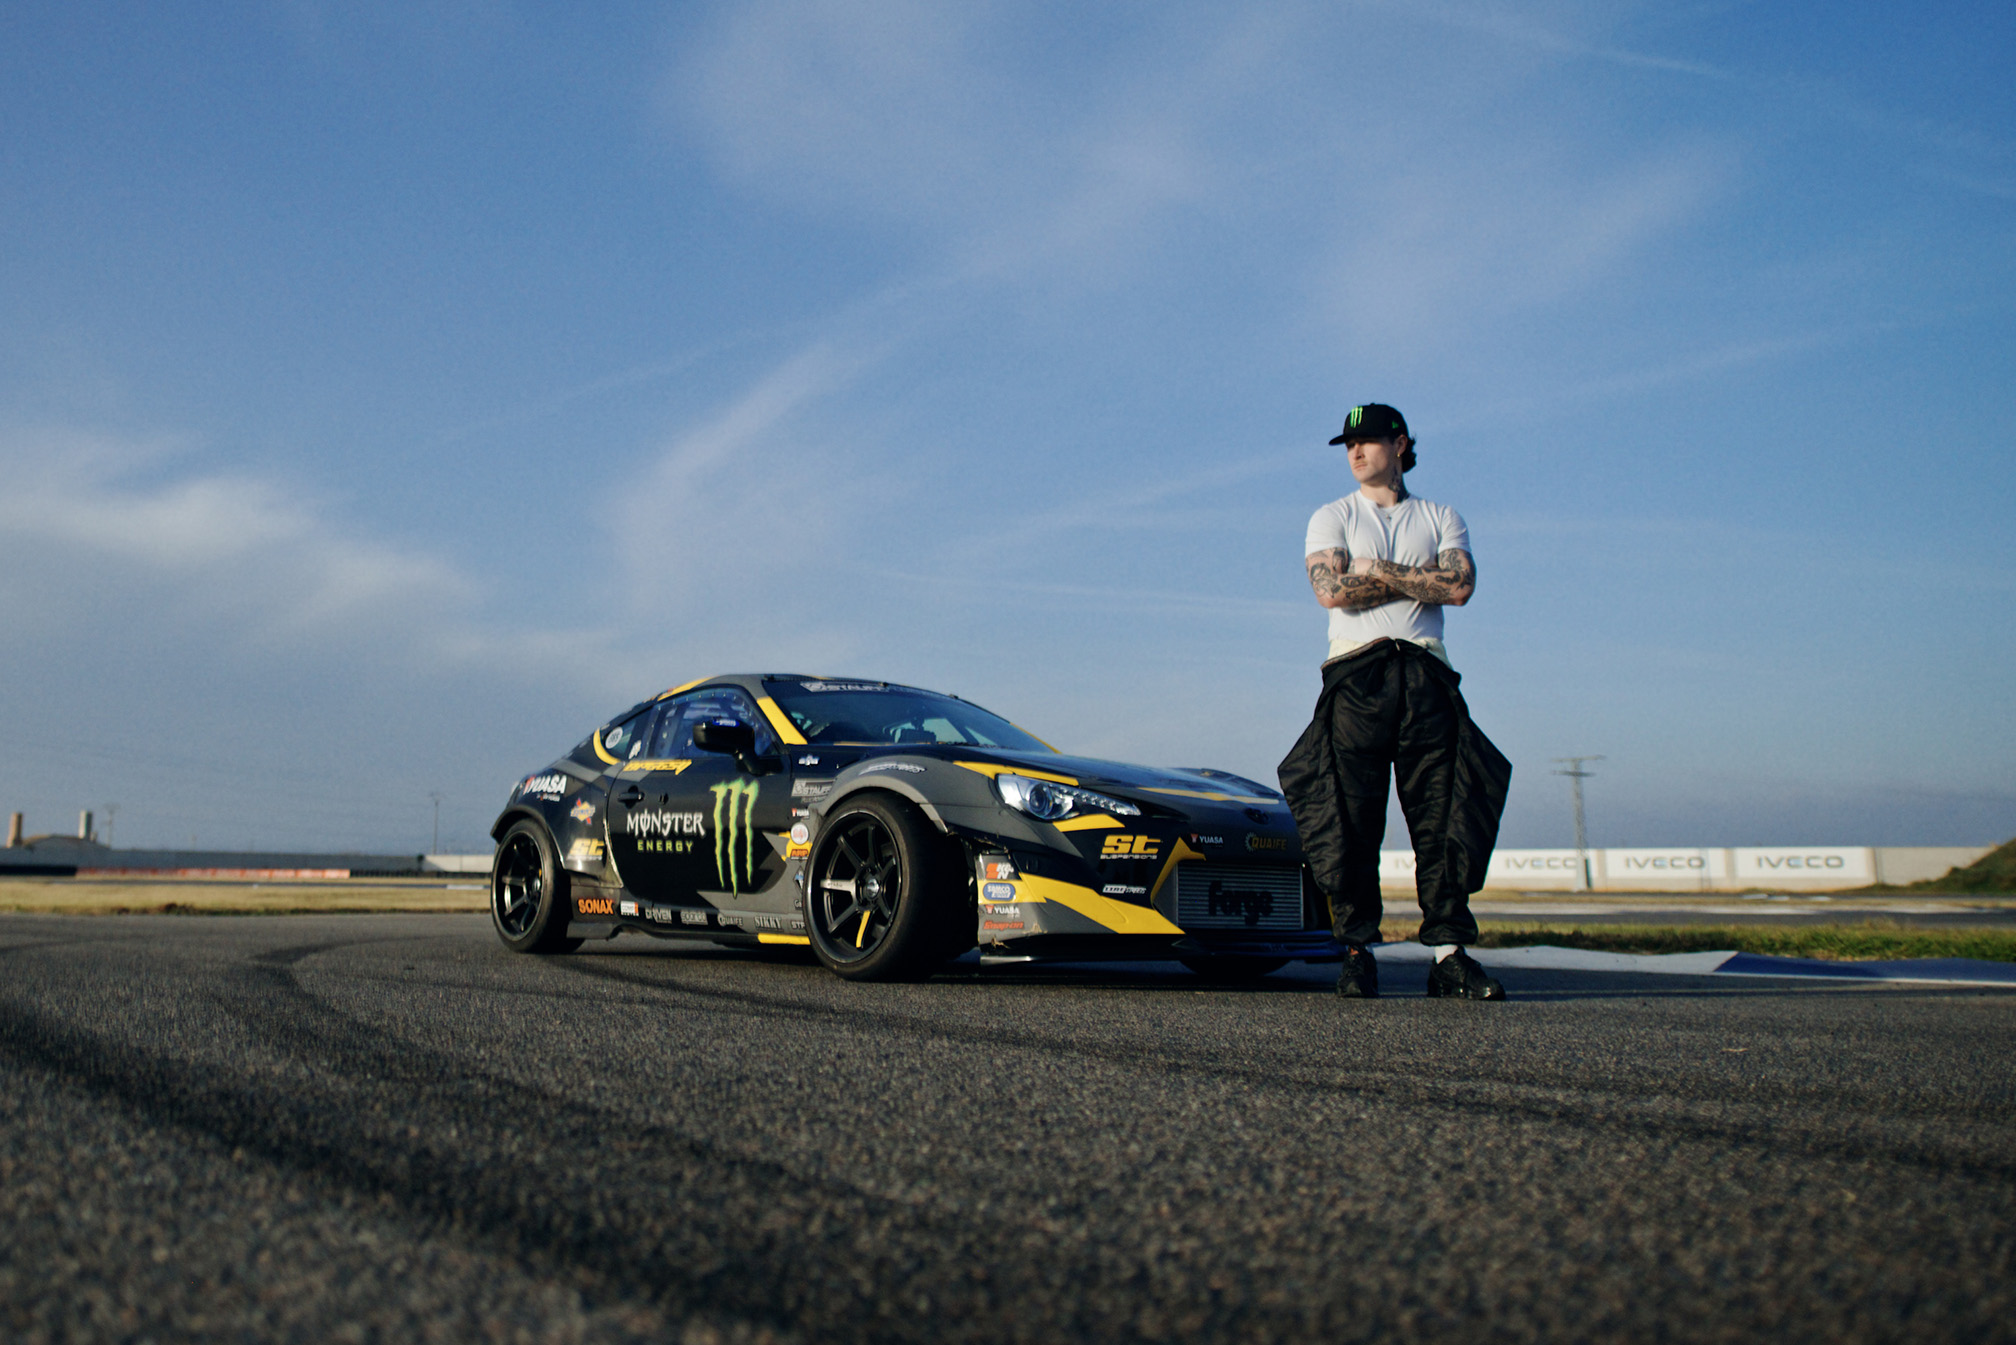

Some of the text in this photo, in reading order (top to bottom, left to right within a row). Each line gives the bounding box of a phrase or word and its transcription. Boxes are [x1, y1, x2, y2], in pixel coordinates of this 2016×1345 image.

[1199, 835, 1223, 844] YUASA
[1251, 837, 1287, 850] QUAIFE
[637, 840, 693, 852] ENERGY
[1625, 857, 1706, 869] IVECO
[1757, 856, 1845, 868] IVECO
[578, 899, 614, 915] SONAX
[994, 905, 1020, 914] YUASA
